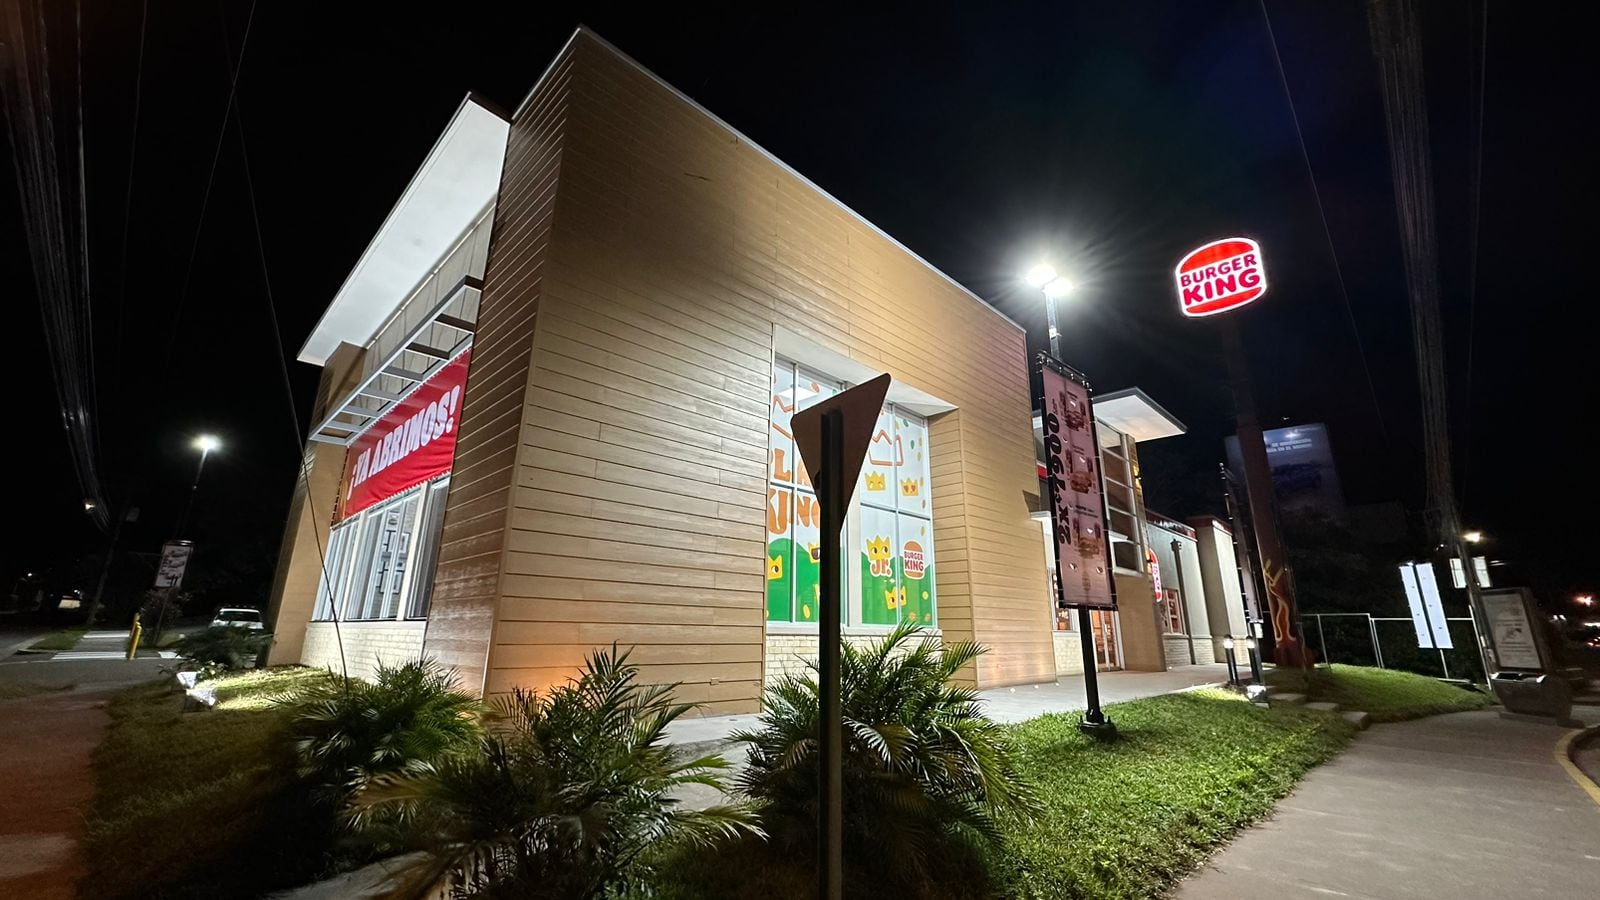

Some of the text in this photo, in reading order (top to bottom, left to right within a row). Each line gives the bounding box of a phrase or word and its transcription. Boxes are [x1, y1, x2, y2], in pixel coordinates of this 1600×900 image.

[1180, 254, 1257, 287] BURGER
[1183, 268, 1260, 305] KING
[347, 385, 461, 500] ¡YA ABRIMOS!
[904, 550, 923, 561] BURGER
[904, 559, 924, 571] KING
